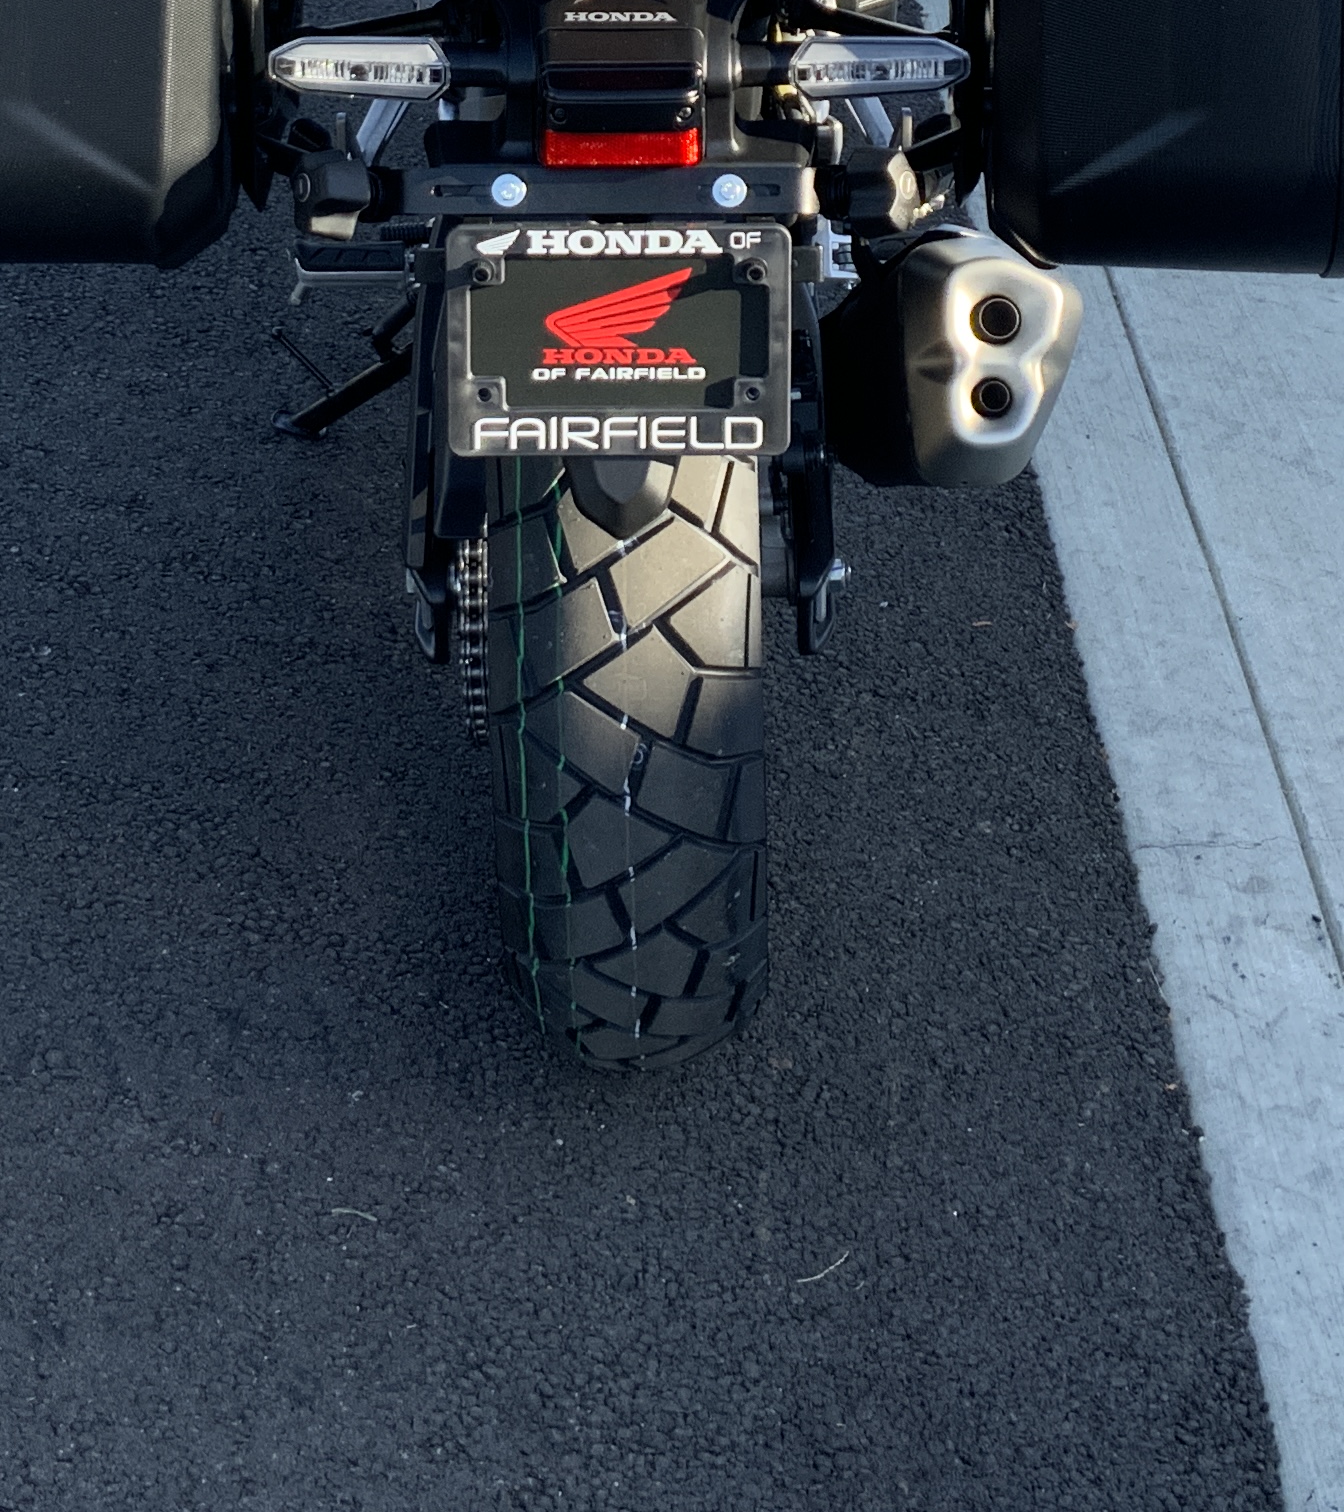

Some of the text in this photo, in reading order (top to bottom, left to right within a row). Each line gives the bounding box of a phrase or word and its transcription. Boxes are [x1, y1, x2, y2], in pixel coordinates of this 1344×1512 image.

[563, 11, 678, 23] HONDA
[526, 229, 762, 255] HONDA OF
[542, 348, 697, 365] HONDA
[532, 367, 706, 381] OF FAIRFIELD
[473, 416, 765, 451] FAIRFIELD
